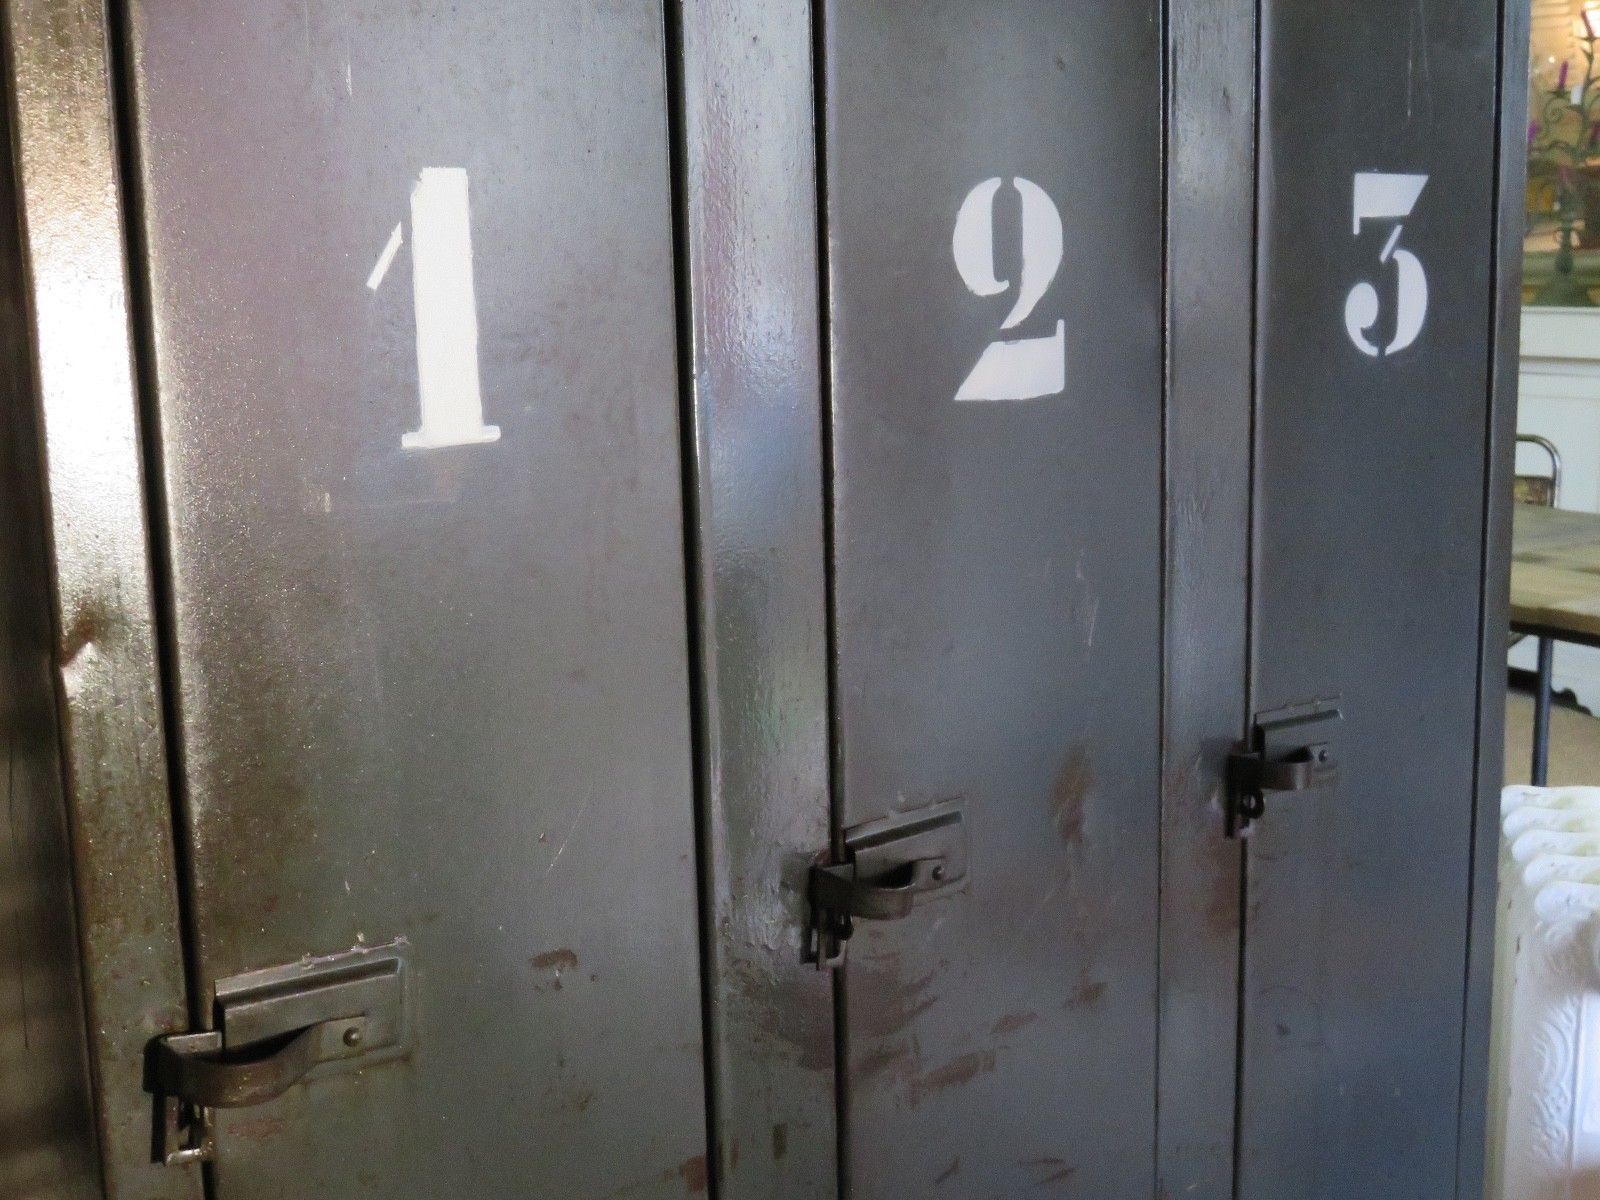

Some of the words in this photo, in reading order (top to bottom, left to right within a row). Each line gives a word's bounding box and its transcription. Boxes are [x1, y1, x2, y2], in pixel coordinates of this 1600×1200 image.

[366, 166, 501, 449] 1
[952, 176, 1066, 402] 2
[1344, 172, 1429, 357] 3
